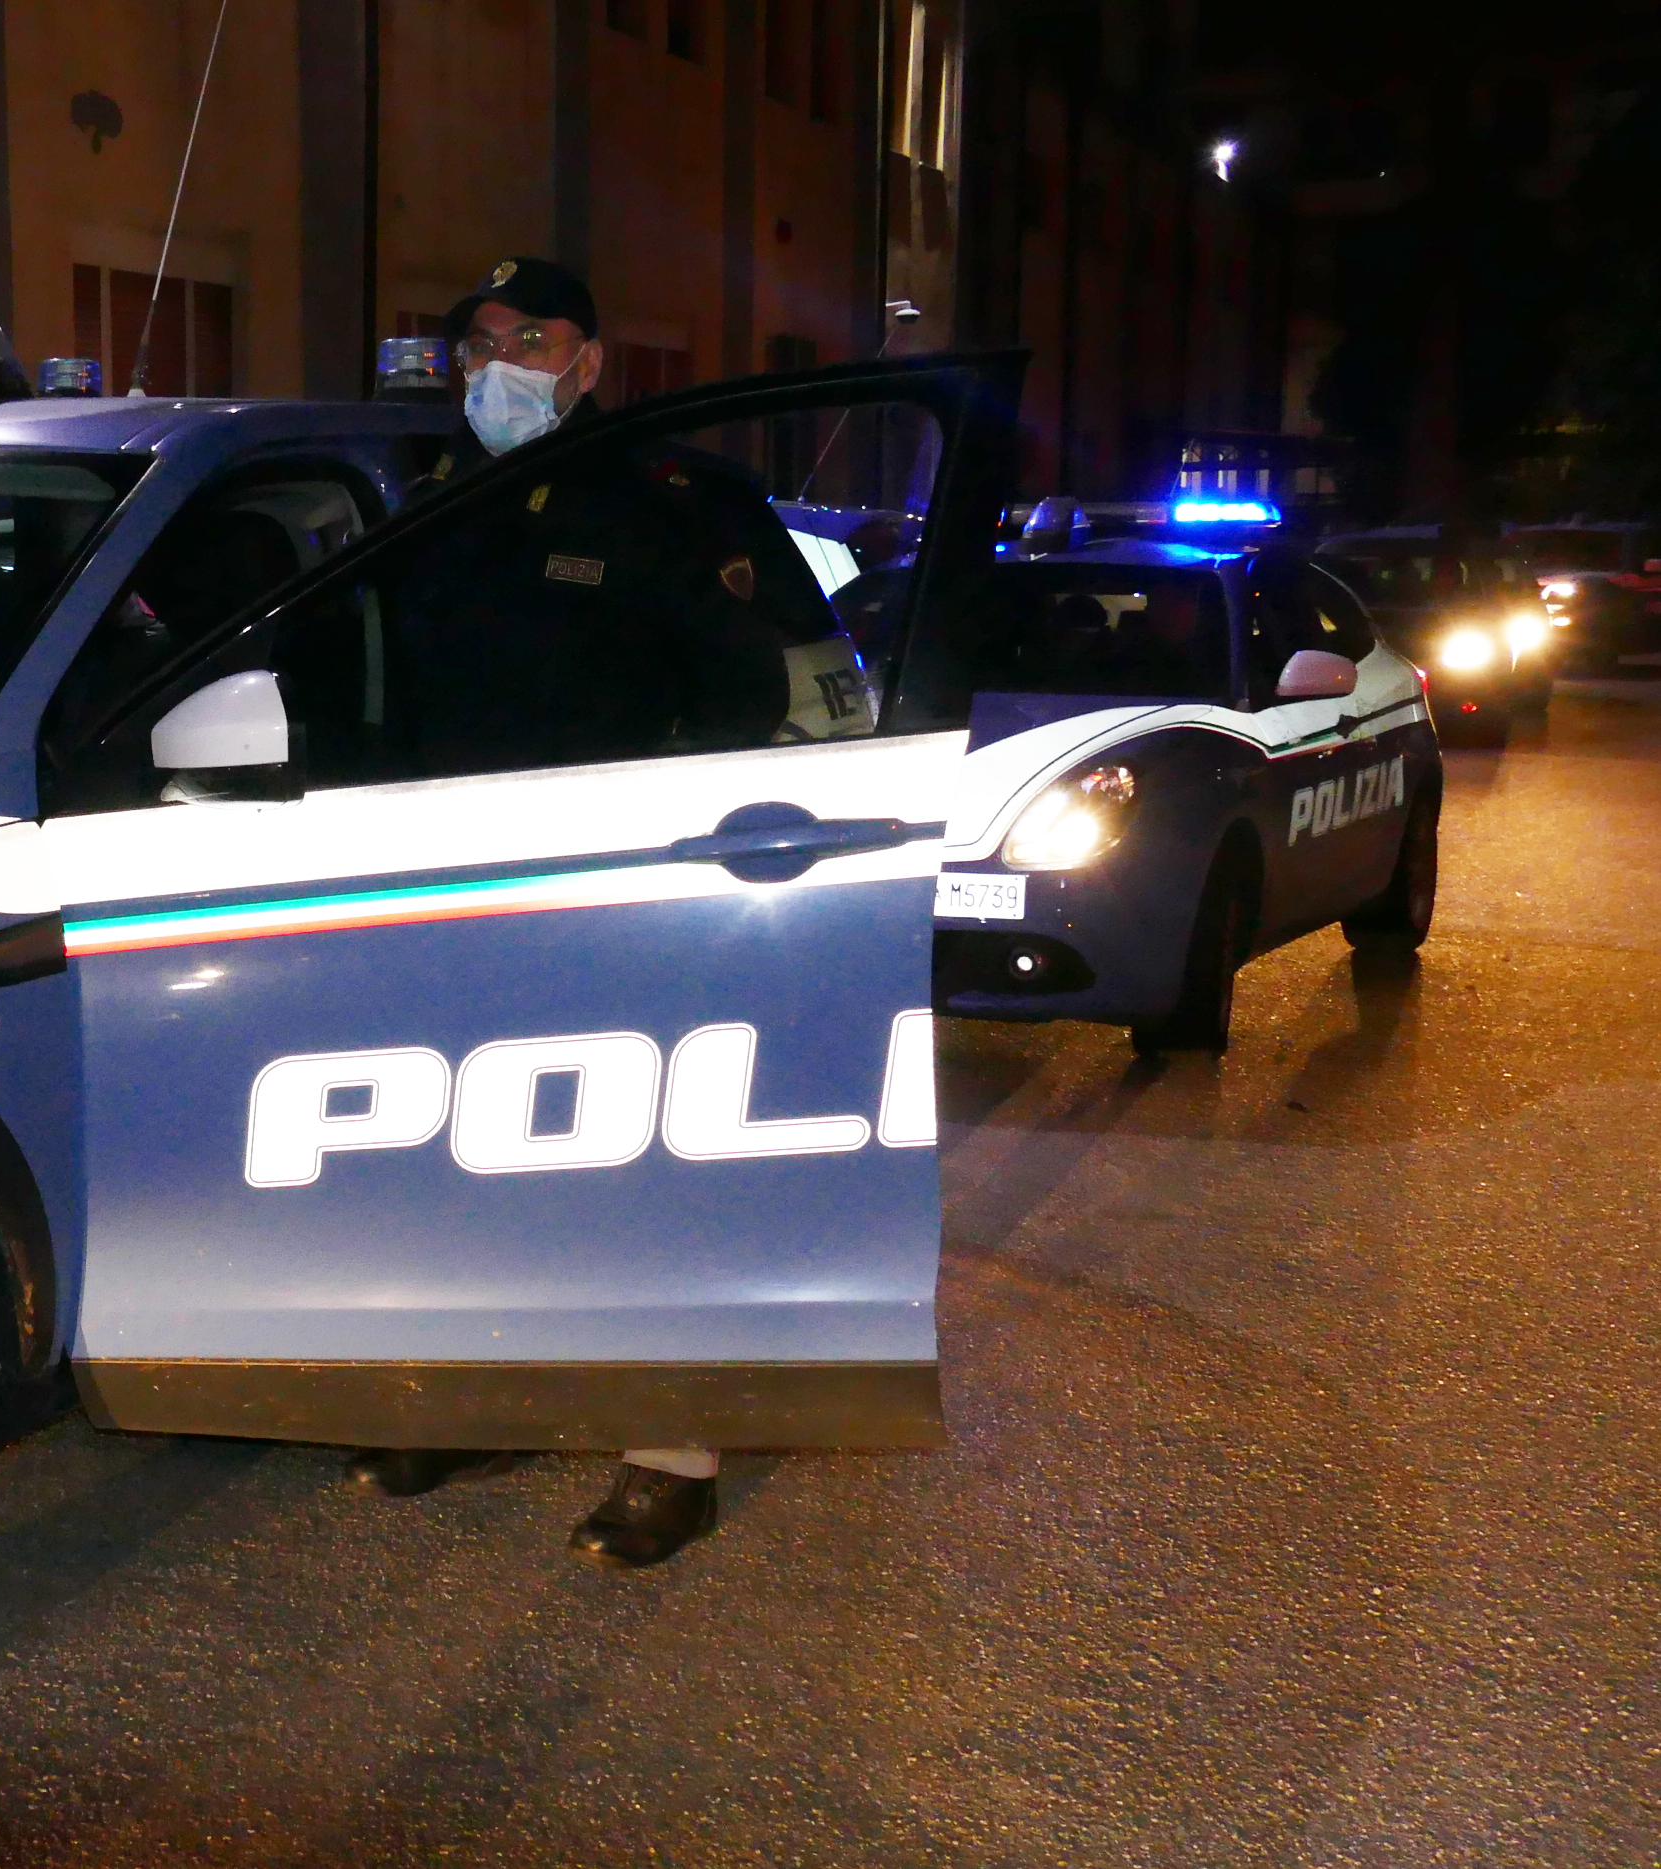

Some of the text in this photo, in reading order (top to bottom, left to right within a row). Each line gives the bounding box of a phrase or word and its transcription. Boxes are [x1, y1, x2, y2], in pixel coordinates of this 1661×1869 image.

[1288, 756, 1404, 847] POLIZIA
[950, 883, 1018, 909] M5739
[244, 1008, 937, 1188] POLI
